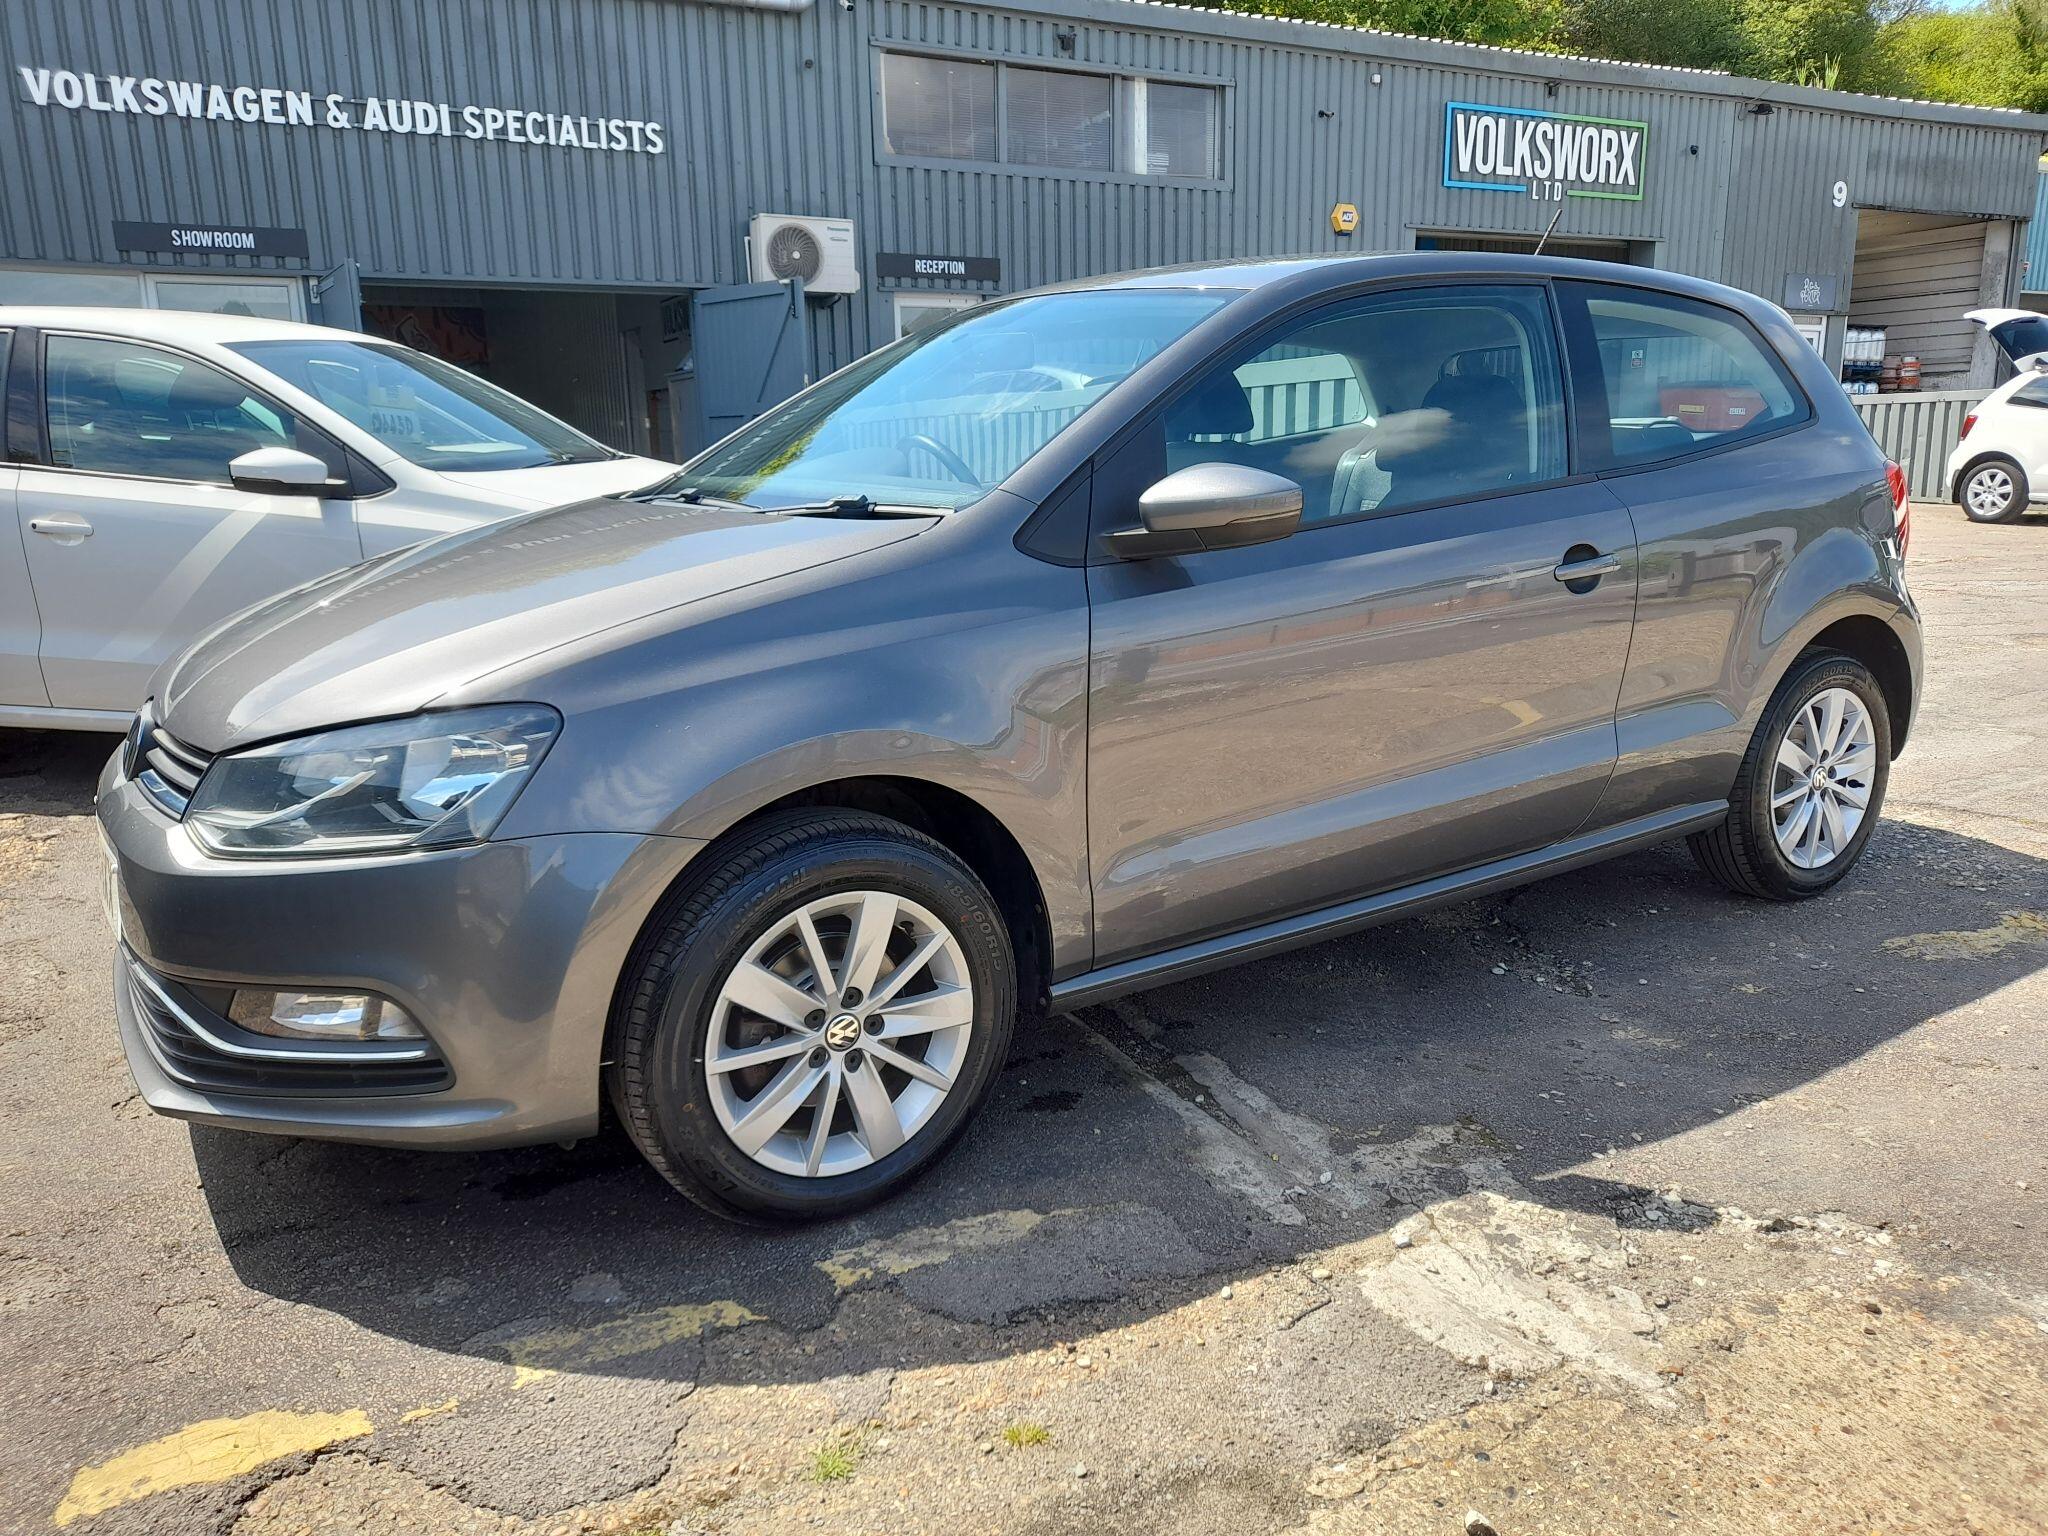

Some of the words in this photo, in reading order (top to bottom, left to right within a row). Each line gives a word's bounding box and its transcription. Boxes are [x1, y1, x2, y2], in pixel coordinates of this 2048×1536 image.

[20, 67, 314, 127] VOLKSWAGEN
[326, 93, 351, 129] &
[363, 97, 452, 136] AUDI
[462, 105, 664, 154] SPECIALISTS
[1456, 113, 1639, 186] VOLKSWORX
[1531, 180, 1563, 202] LTD
[1832, 180, 1848, 208] 9
[171, 229, 255, 249] SHOWROOM
[914, 259, 965, 275] RECEPTION
